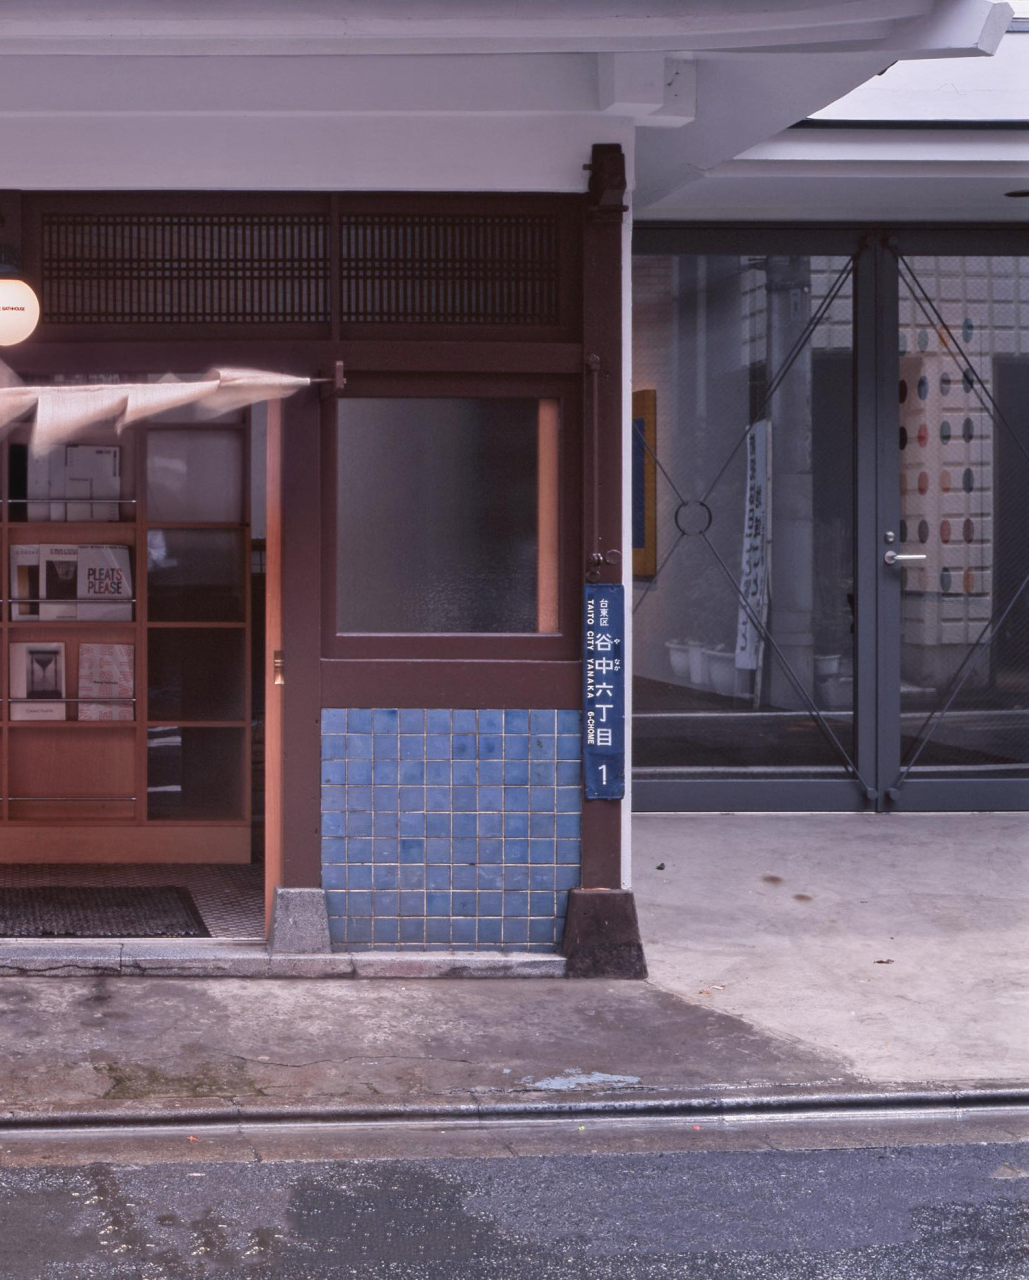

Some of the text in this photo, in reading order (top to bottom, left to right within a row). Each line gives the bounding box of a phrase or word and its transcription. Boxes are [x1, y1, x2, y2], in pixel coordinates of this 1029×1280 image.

[87, 567, 123, 582] PLEATS
[87, 581, 123, 595] PLEASE
[599, 598, 609, 627] 台東区
[587, 599, 595, 745] TAITO CITY YANAKA 6-CHOME
[595, 633, 614, 746] 谷中六丁目
[598, 764, 607, 786] 1
